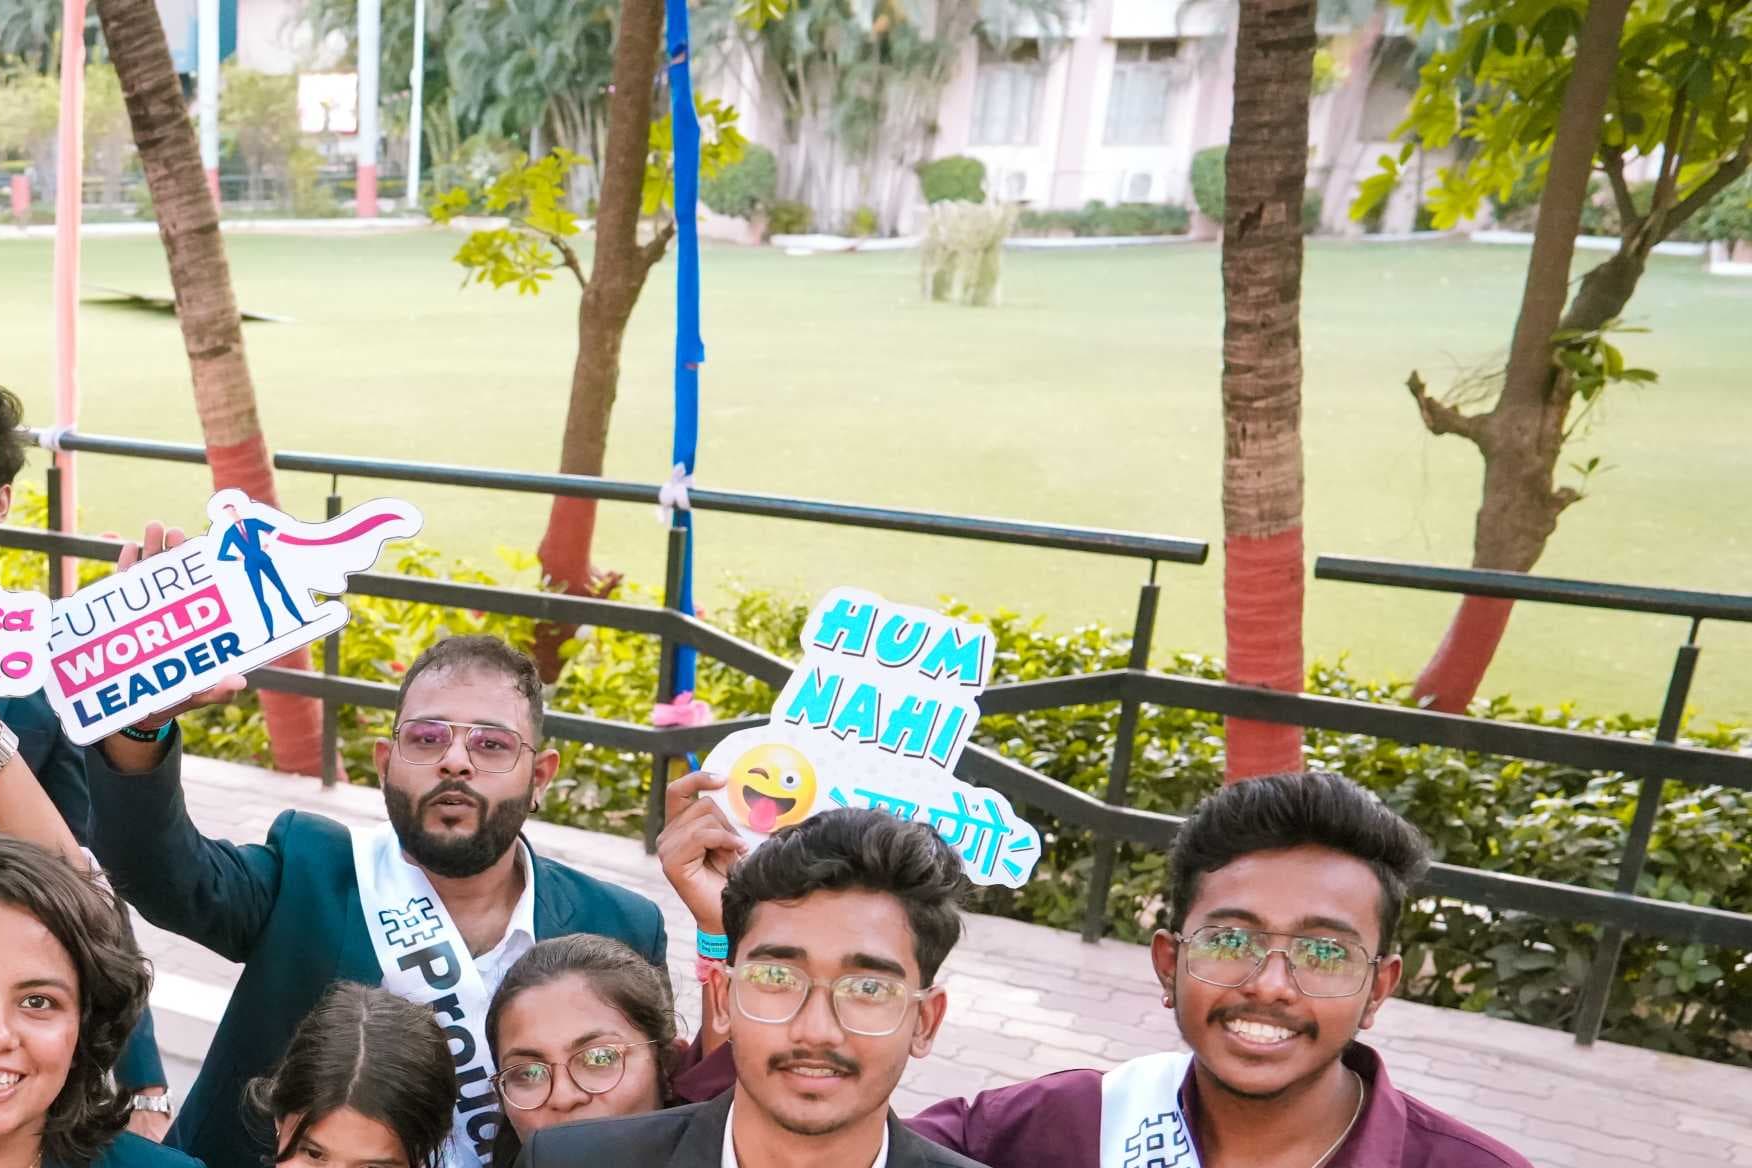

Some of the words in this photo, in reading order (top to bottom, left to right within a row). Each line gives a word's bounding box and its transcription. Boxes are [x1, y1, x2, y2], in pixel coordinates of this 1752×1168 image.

[58, 596, 221, 686] WORLD
[73, 631, 245, 728] LEADER
[814, 599, 986, 687] HUM
[784, 666, 967, 768] NAHI
